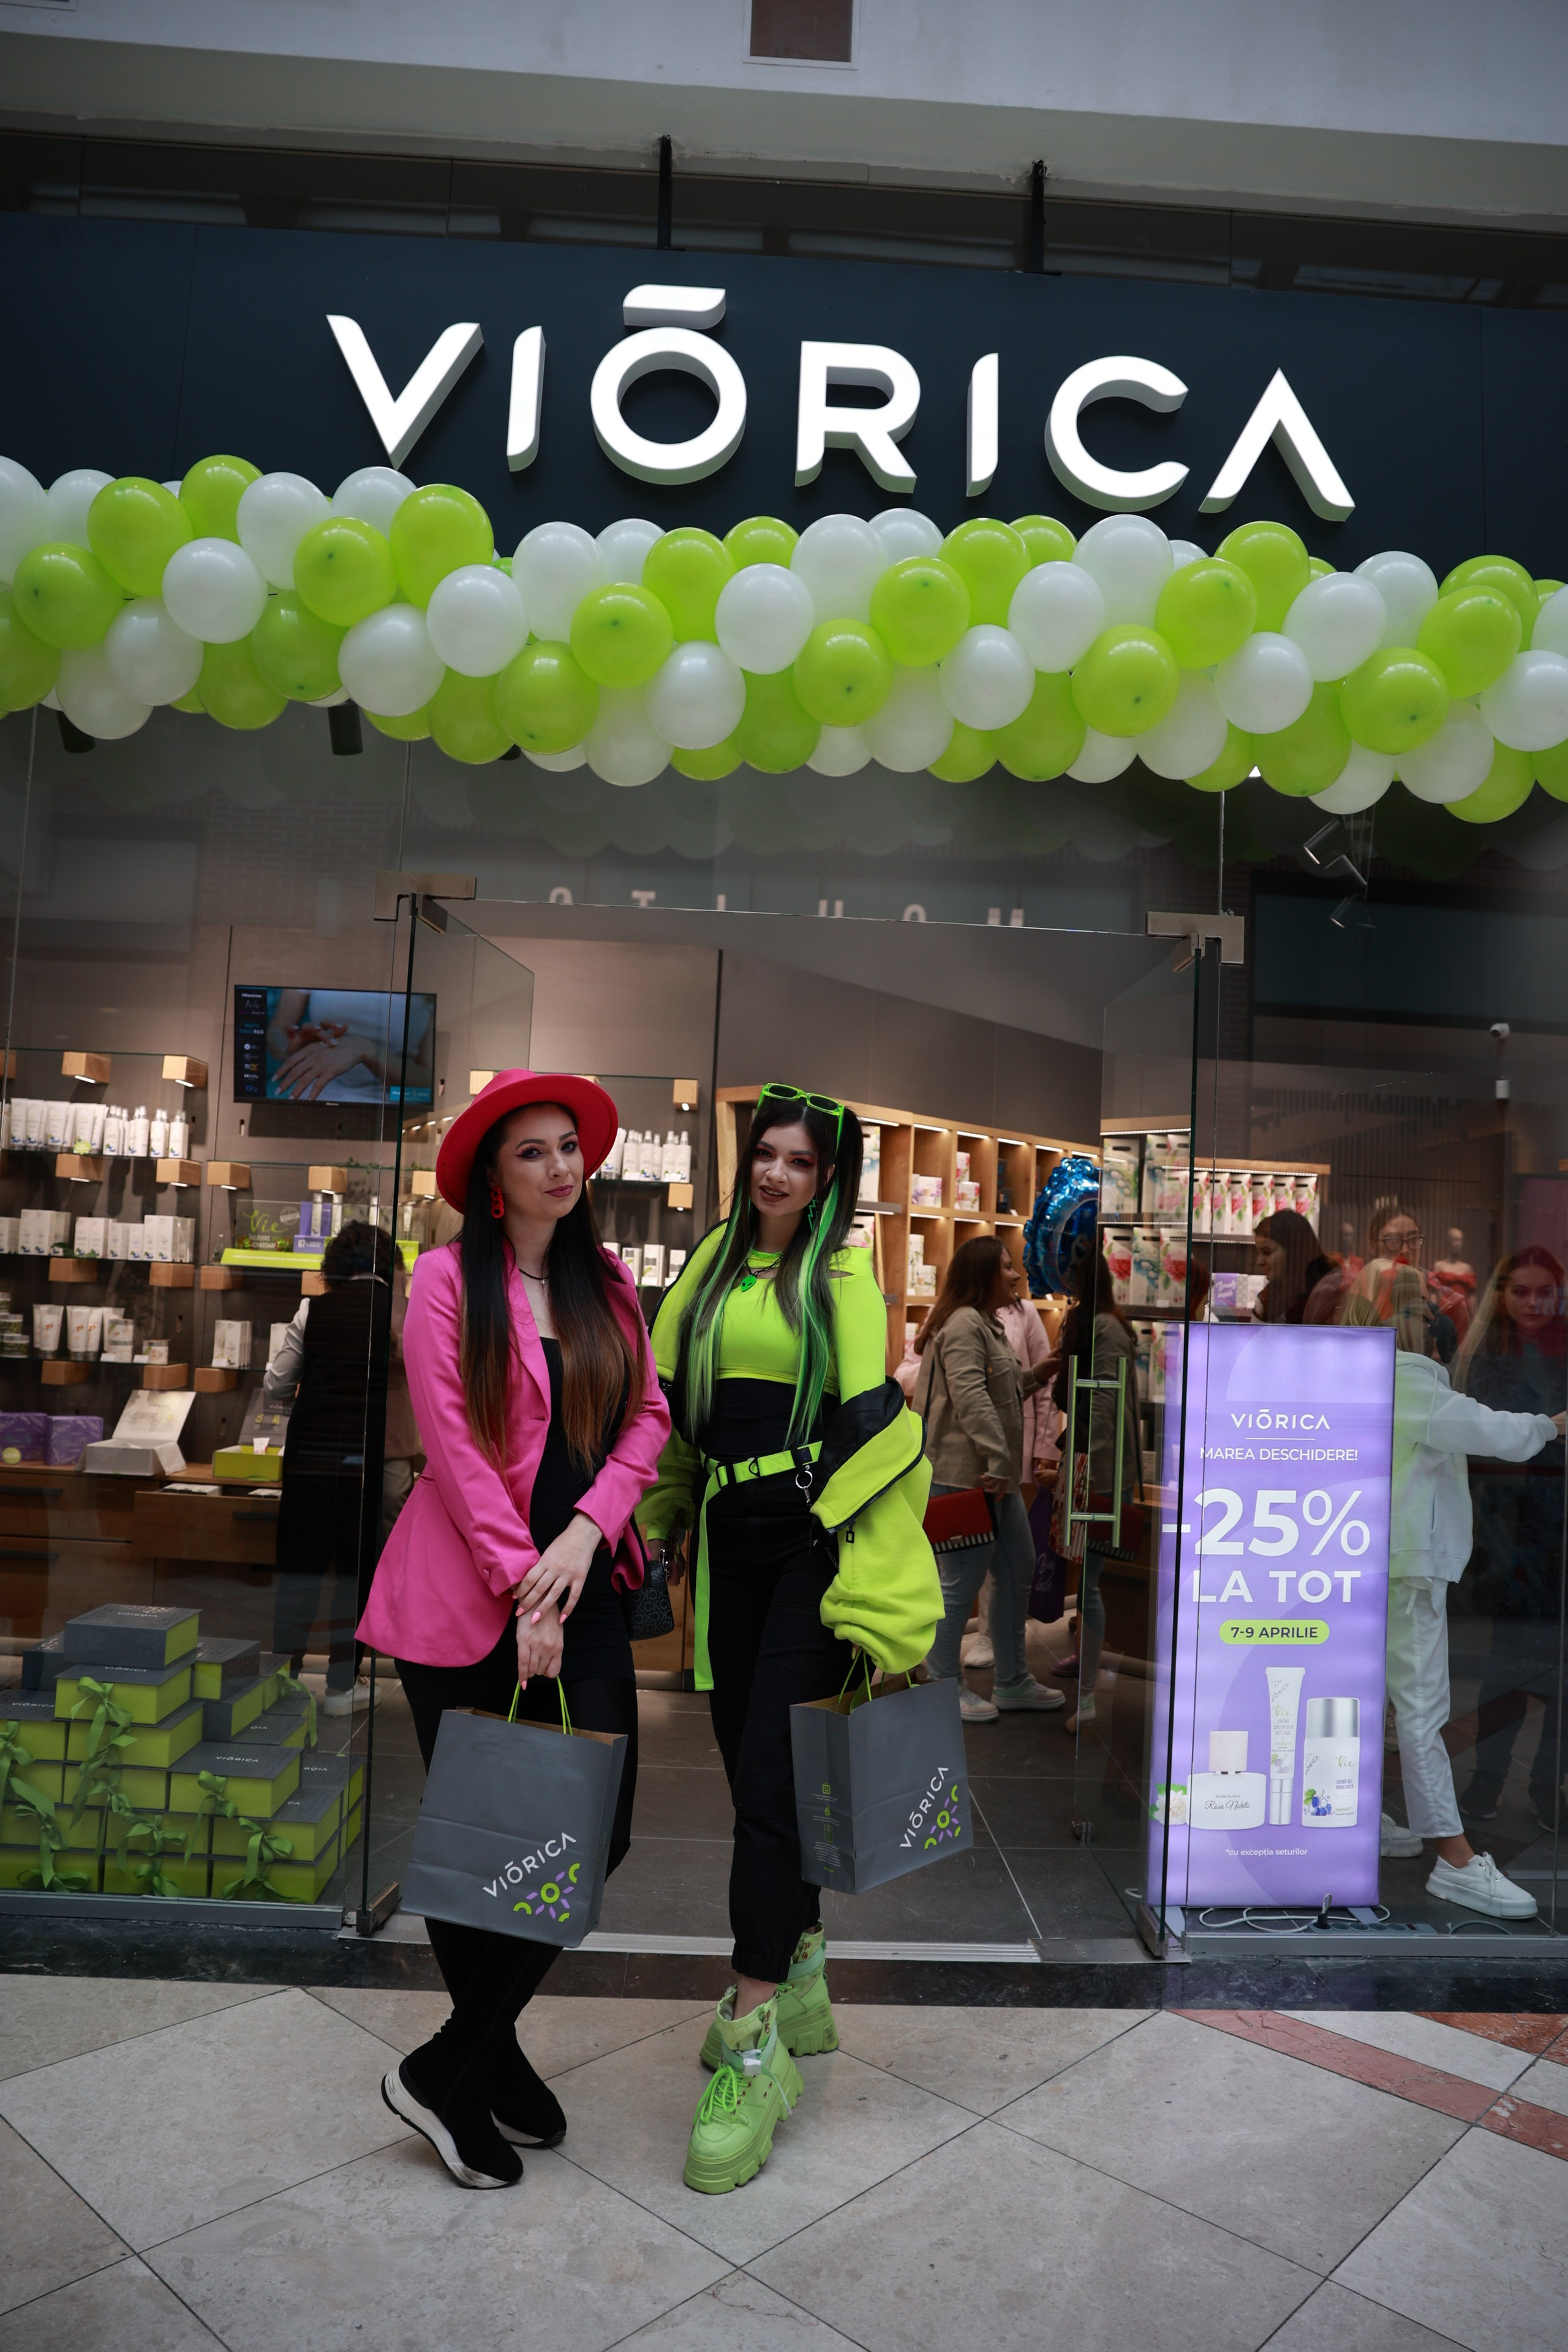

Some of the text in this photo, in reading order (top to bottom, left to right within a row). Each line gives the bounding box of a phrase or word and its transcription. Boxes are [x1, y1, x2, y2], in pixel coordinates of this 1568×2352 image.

[326, 284, 1355, 521] VIŌRICA
[1231, 1409, 1330, 1430] VIŌRICA
[1200, 1447, 1358, 1461] MAREA DESCHIDERE!
[1162, 1488, 1371, 1558] -25%
[1191, 1569, 1361, 1604] LA TOT
[1231, 1625, 1318, 1639] 7-9 APRILIE
[900, 1766, 949, 1847] VIŌRICA
[1204, 1800, 1224, 1810] Rosa
[483, 1832, 576, 1898] VIŌRICA
[1240, 1848, 1273, 1857] excepția
